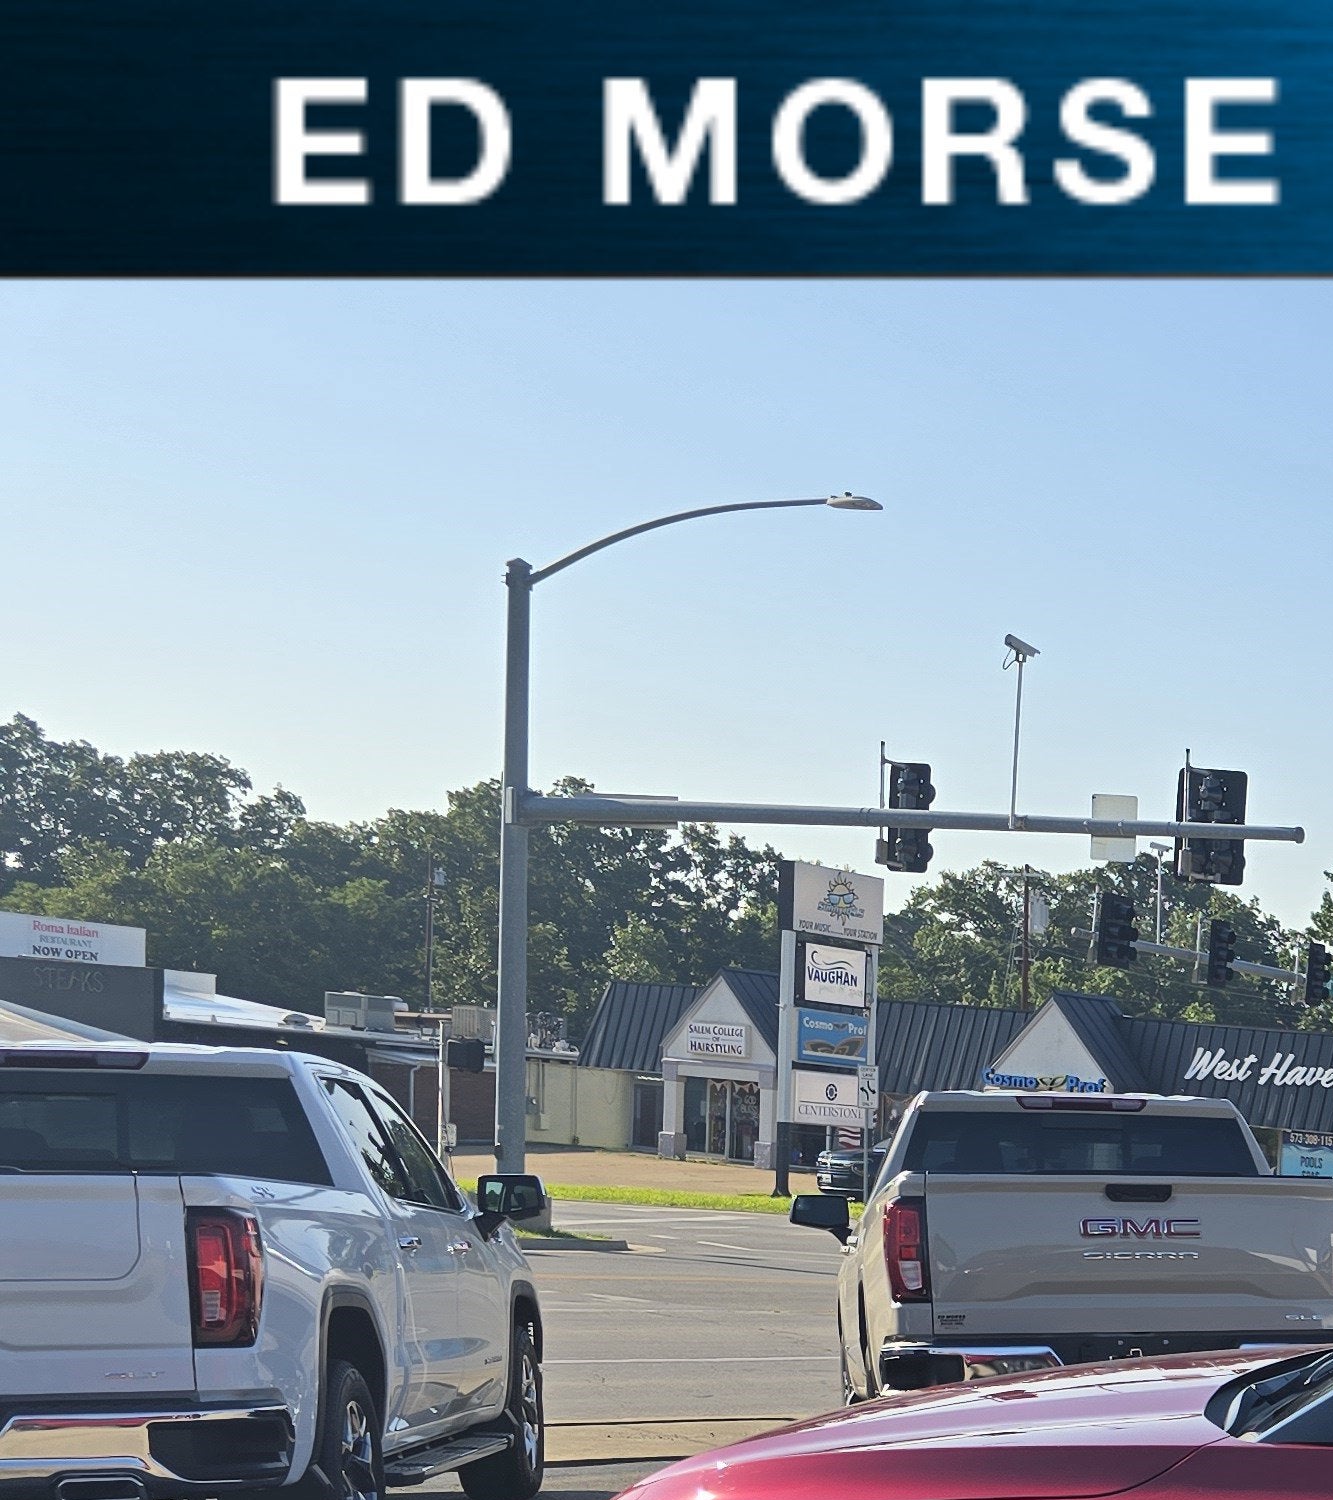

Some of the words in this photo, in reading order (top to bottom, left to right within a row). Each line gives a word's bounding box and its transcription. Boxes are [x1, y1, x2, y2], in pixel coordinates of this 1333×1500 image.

[33, 920, 63, 933] Roma
[66, 924, 99, 938] Italian
[39, 934, 92, 948] RESTAURANT
[32, 945, 62, 957] NOW
[65, 949, 99, 961] OPEN
[807, 965, 858, 987] VAUGHAN
[688, 1024, 711, 1035] SALEM
[712, 1026, 744, 1037] COLLEGE
[803, 1017, 834, 1031] Cosmo
[690, 1040, 742, 1055] HAIRSTYLING
[1183, 1047, 1259, 1082] West
[982, 1067, 1039, 1090] Cosmo
[1066, 1074, 1107, 1094] Prof
[798, 1105, 863, 1120] CENTERSTONE
[1300, 1155, 1324, 1169] POOLS
[1080, 1217, 1201, 1239] GMC
[1083, 1251, 1199, 1260] SIERRA
